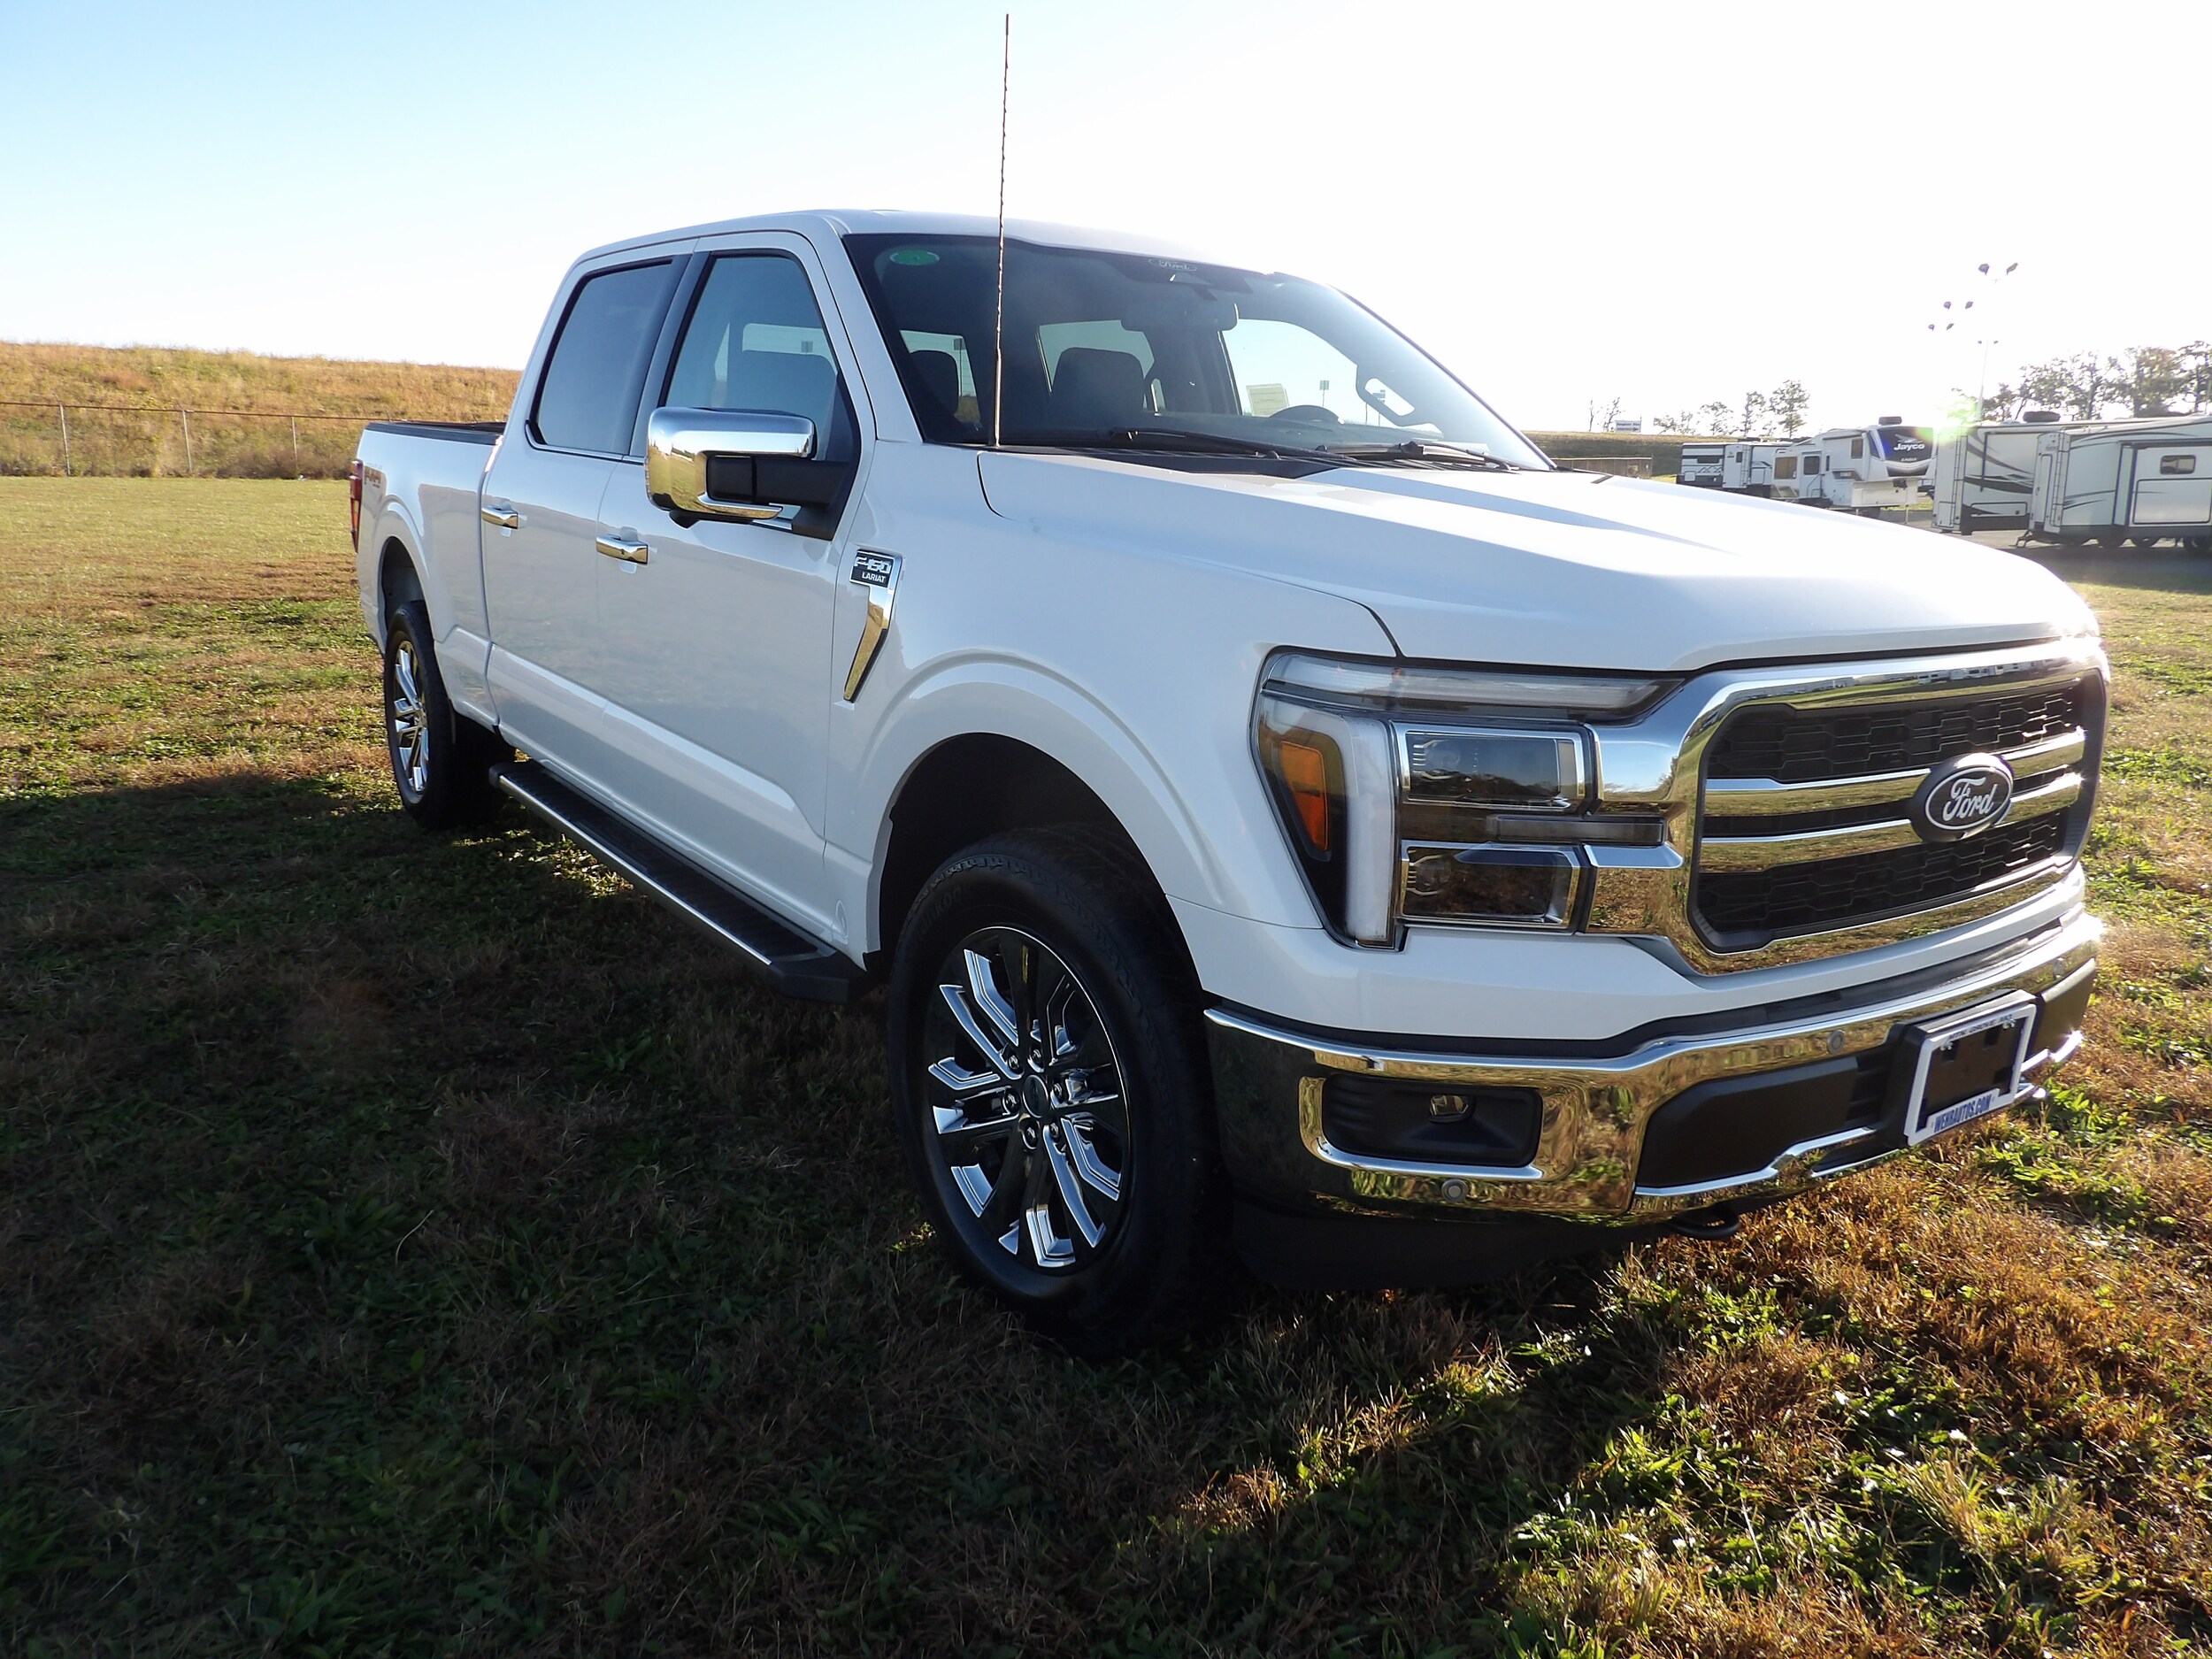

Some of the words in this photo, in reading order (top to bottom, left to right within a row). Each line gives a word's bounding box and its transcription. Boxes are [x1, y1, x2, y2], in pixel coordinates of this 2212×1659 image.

[854, 556, 892, 574] F-150
[862, 572, 887, 583] LARIAT
[1942, 777, 1999, 821] Ford
